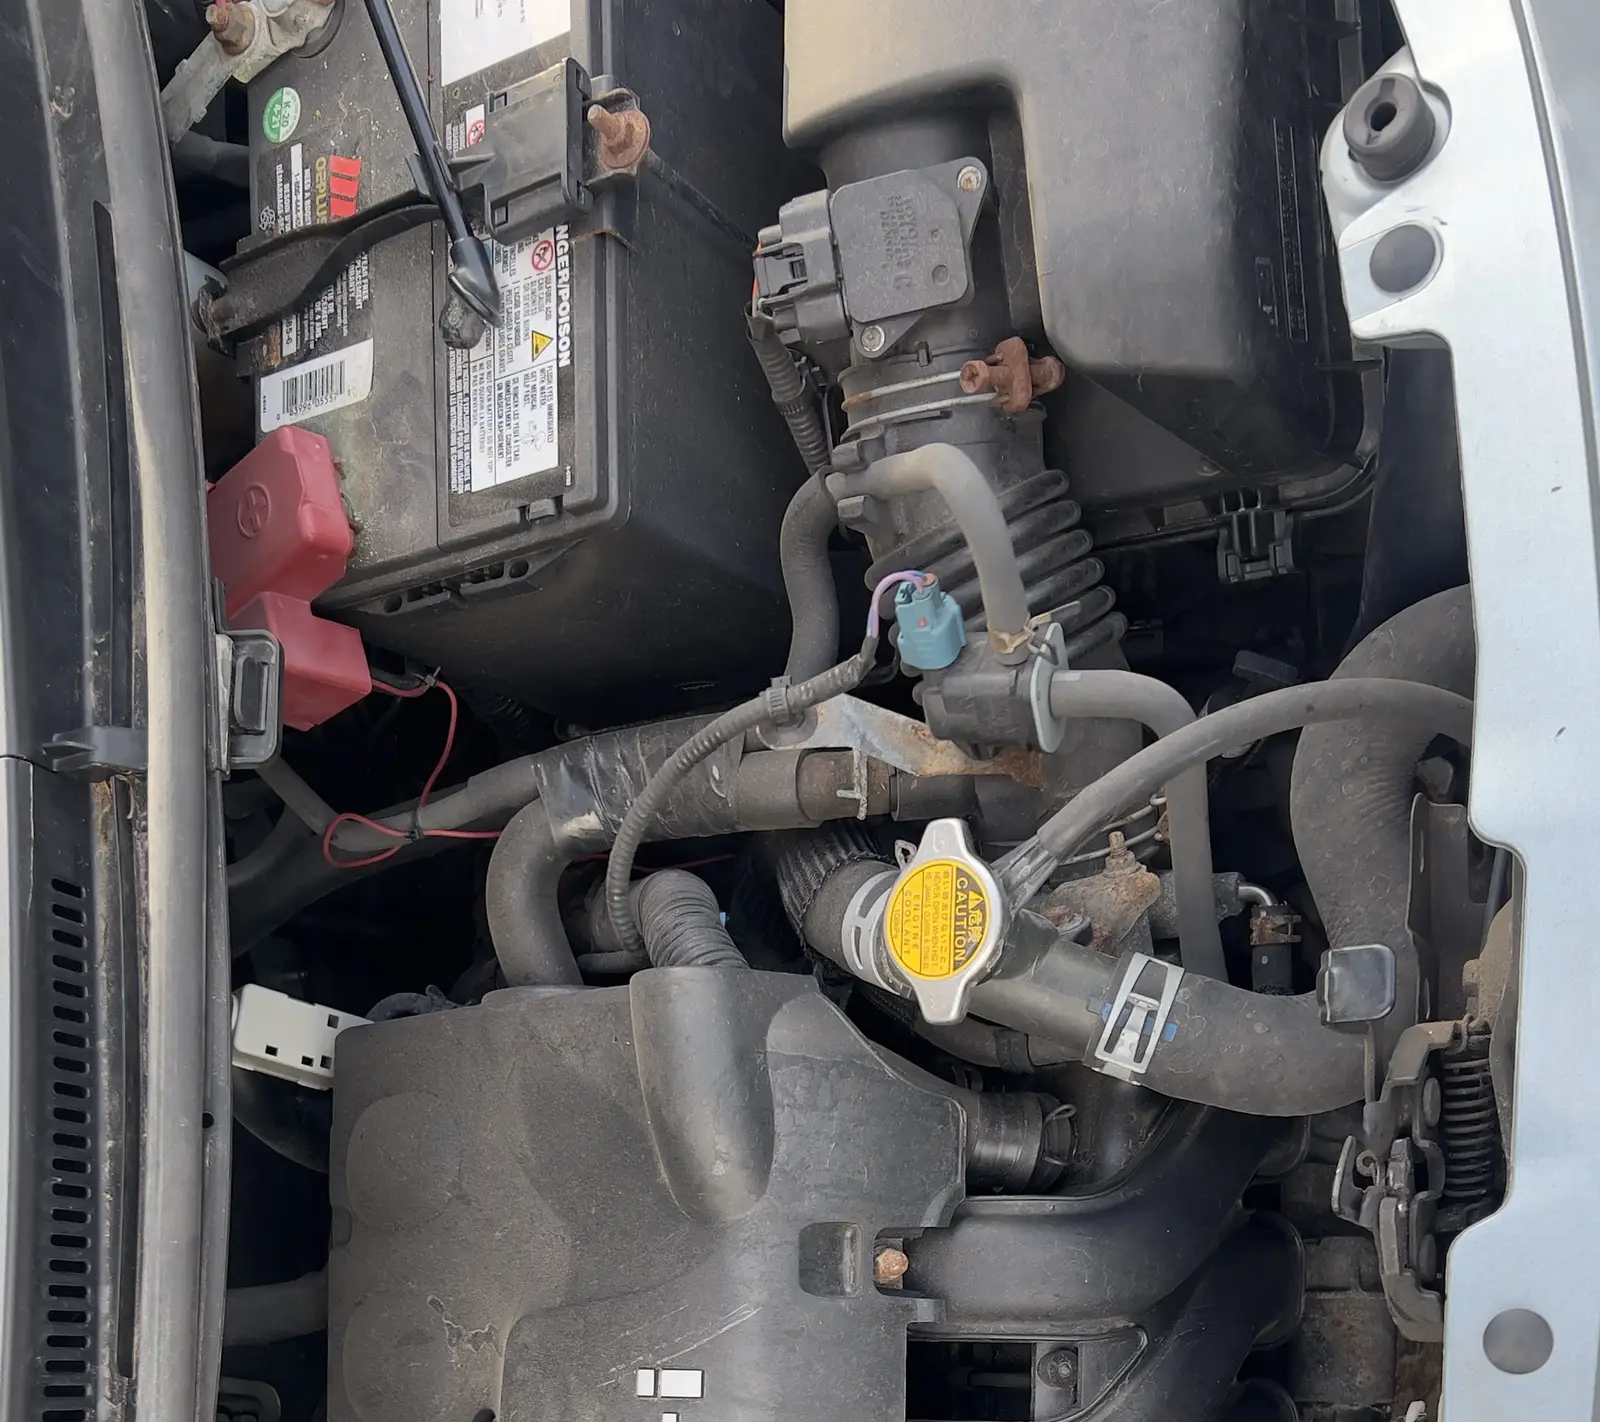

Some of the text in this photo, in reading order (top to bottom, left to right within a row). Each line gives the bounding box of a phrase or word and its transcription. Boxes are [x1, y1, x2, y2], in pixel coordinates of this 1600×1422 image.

[282, 100, 292, 128] K-20
[556, 224, 570, 368] NGER/POISON
[932, 871, 940, 898] NEVER
[904, 890, 912, 954] COOLANT
[912, 894, 920, 950] ENGINE
[932, 900, 940, 924] OPEN
[955, 877, 968, 960] CAUTION
[932, 925, 940, 948] WHEN
